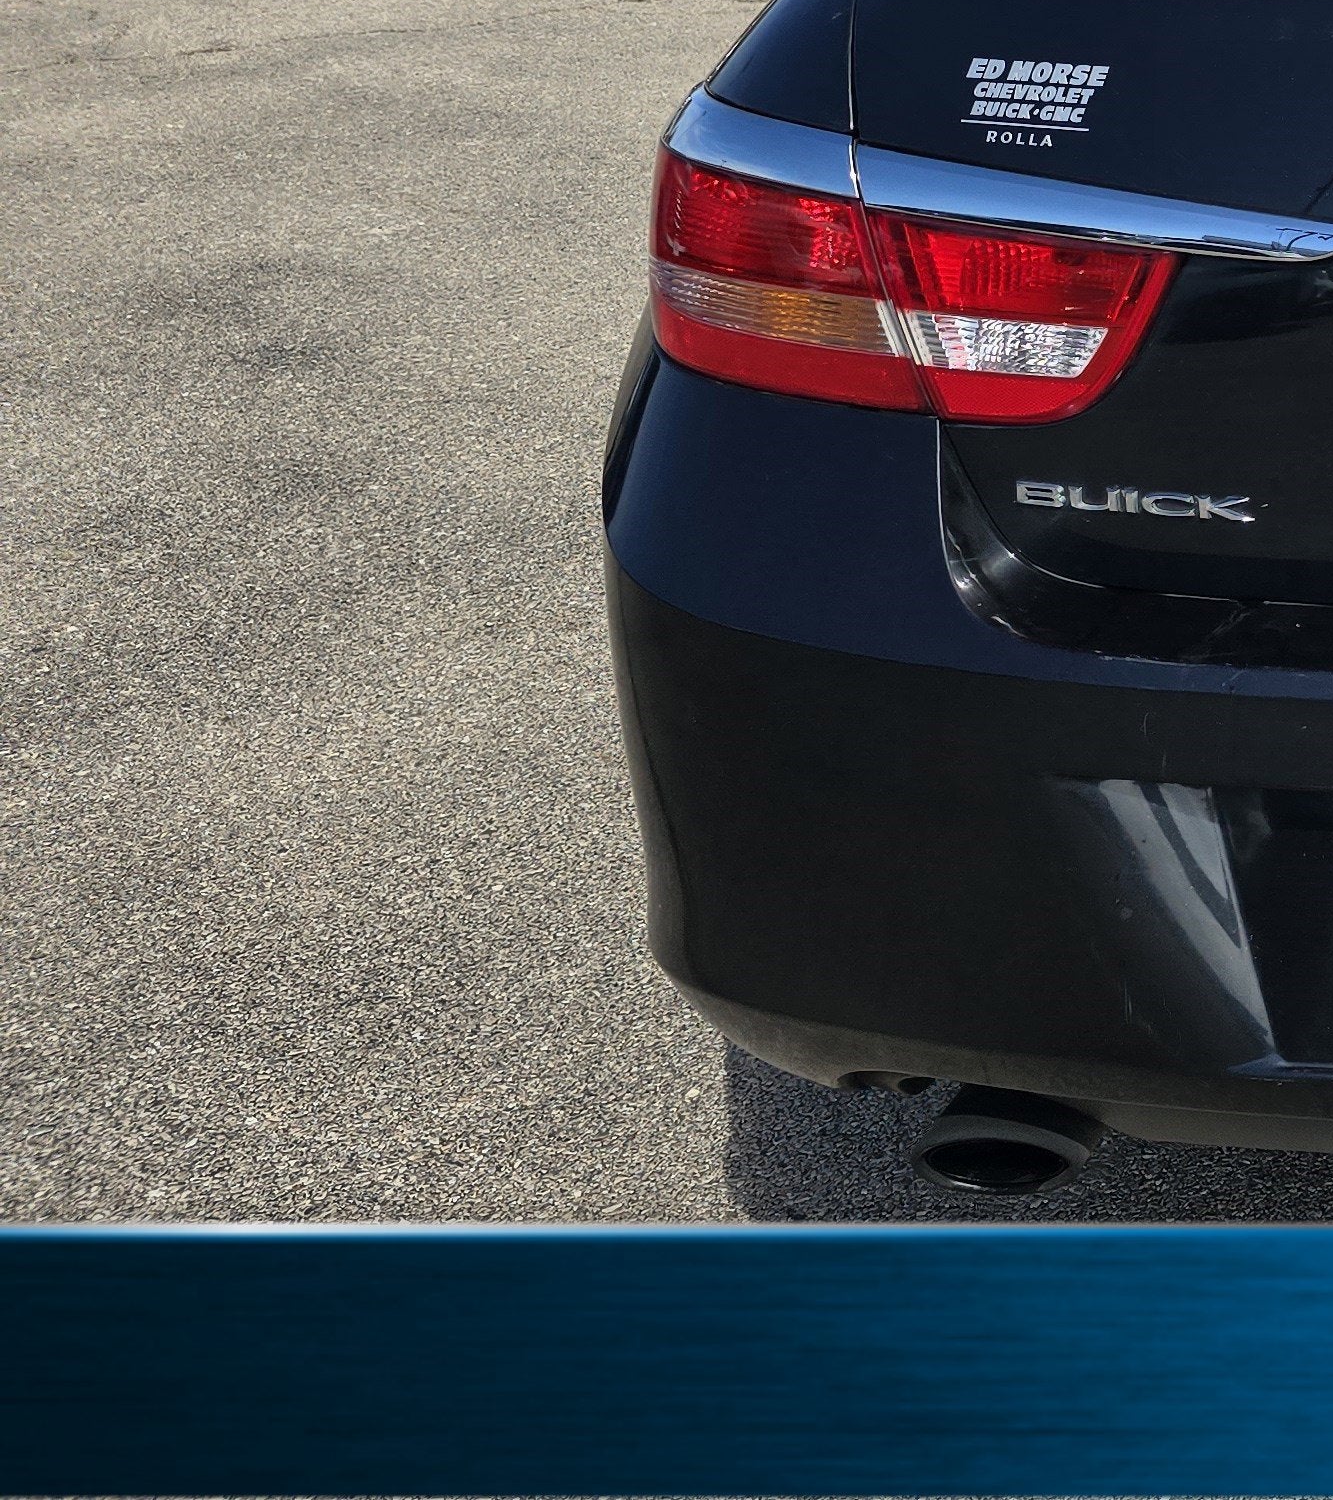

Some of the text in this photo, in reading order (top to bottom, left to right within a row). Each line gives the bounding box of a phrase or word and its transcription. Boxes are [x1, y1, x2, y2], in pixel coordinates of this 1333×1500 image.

[965, 57, 1111, 87] ED MORSE
[973, 81, 1096, 105] CHEVROLET
[985, 130, 1053, 147] ROLLA
[1015, 479, 1256, 523] BUICK
